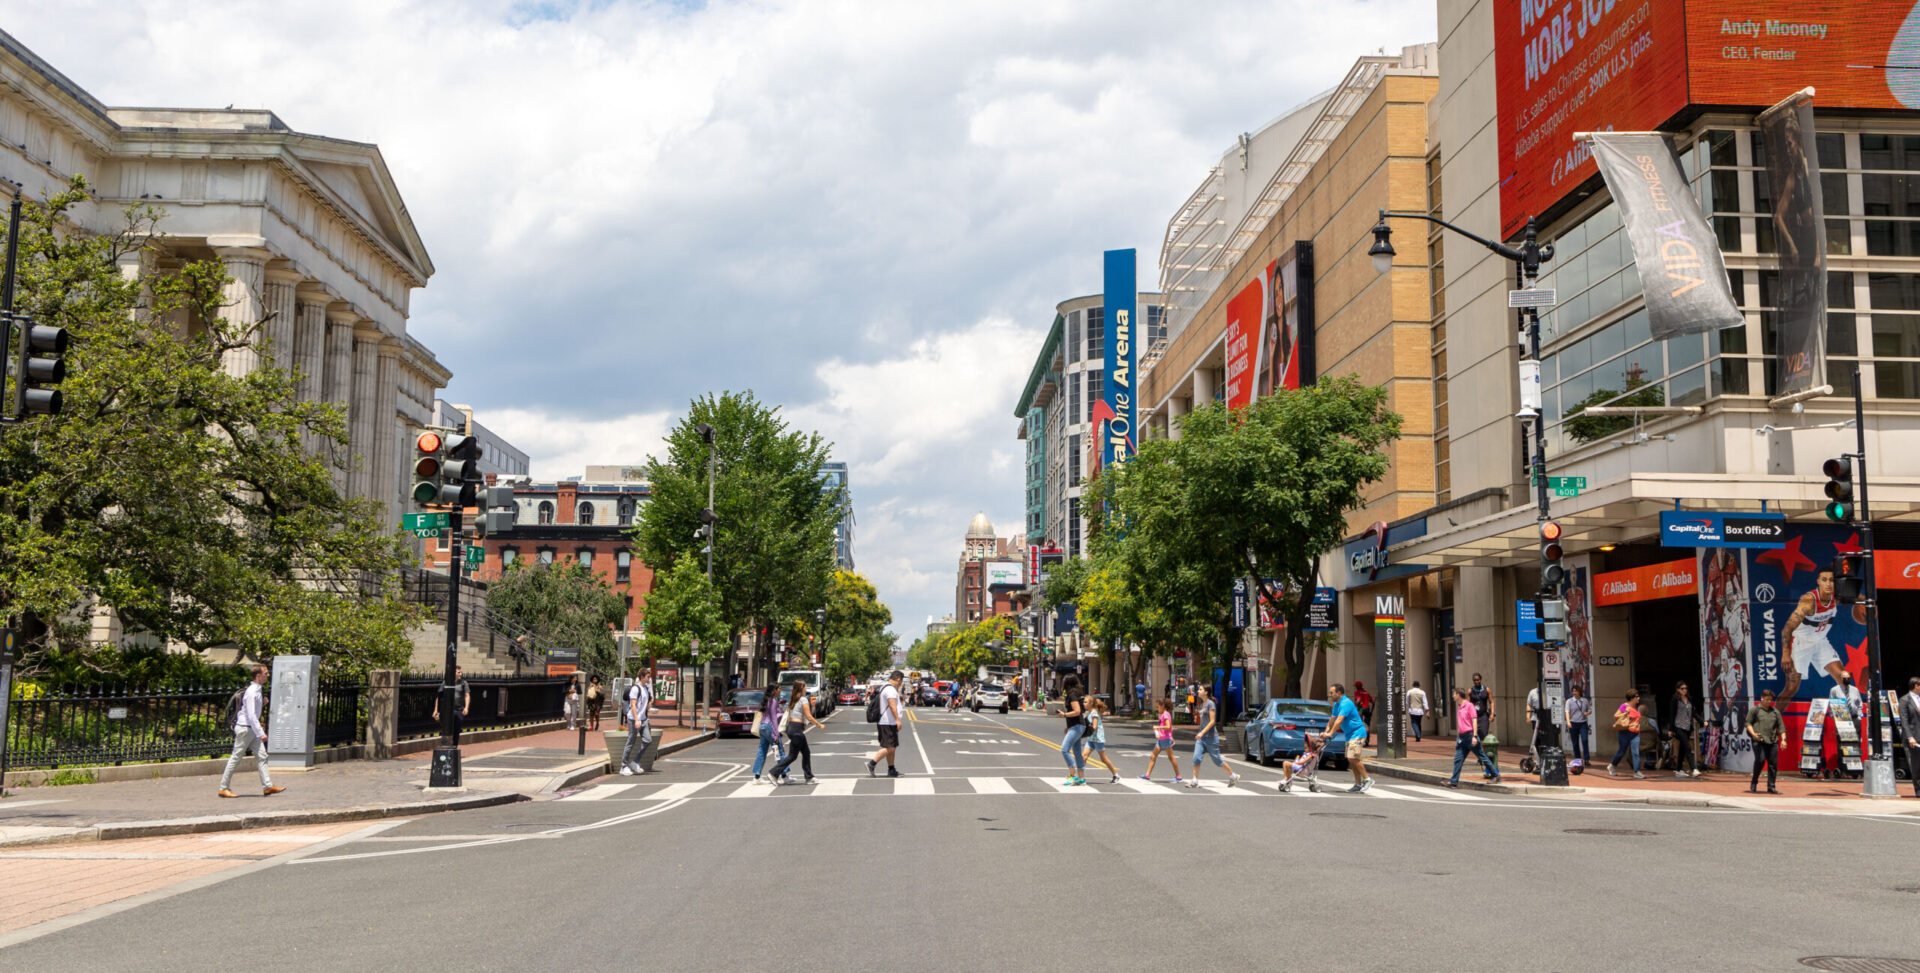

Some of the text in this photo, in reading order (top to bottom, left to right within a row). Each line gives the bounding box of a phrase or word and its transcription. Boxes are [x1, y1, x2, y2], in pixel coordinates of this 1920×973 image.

[1721, 18, 1827, 39] Andy Mooney
[1524, 3, 1574, 90] MORE
[1578, 0, 1623, 38] JO
[1723, 47, 1796, 61] CEO, Fender
[1530, 94, 1548, 120] sales
[1549, 86, 1557, 103] to
[1558, 58, 1588, 96] Chinese
[1589, 14, 1635, 66] consumers
[1638, 2, 1650, 23] on
[1516, 30, 1654, 160] Alibaba support over 390K U.S. jobs.
[1637, 155, 1705, 298] VIDA FITNESS
[1113, 309, 1130, 388] Arena
[1786, 352, 1811, 373] VIDA
[1561, 478, 1568, 488] F
[416, 514, 426, 526] F
[416, 529, 438, 538] 700
[1726, 526, 1743, 534] Box
[1745, 526, 1772, 535] Office
[469, 548, 475, 560] 7
[1610, 580, 1637, 594] Alibaba
[1662, 572, 1692, 587] Alibaba
[1376, 596, 1392, 615] M
[1394, 597, 1404, 615] M
[1764, 609, 1777, 680] KUZMA
